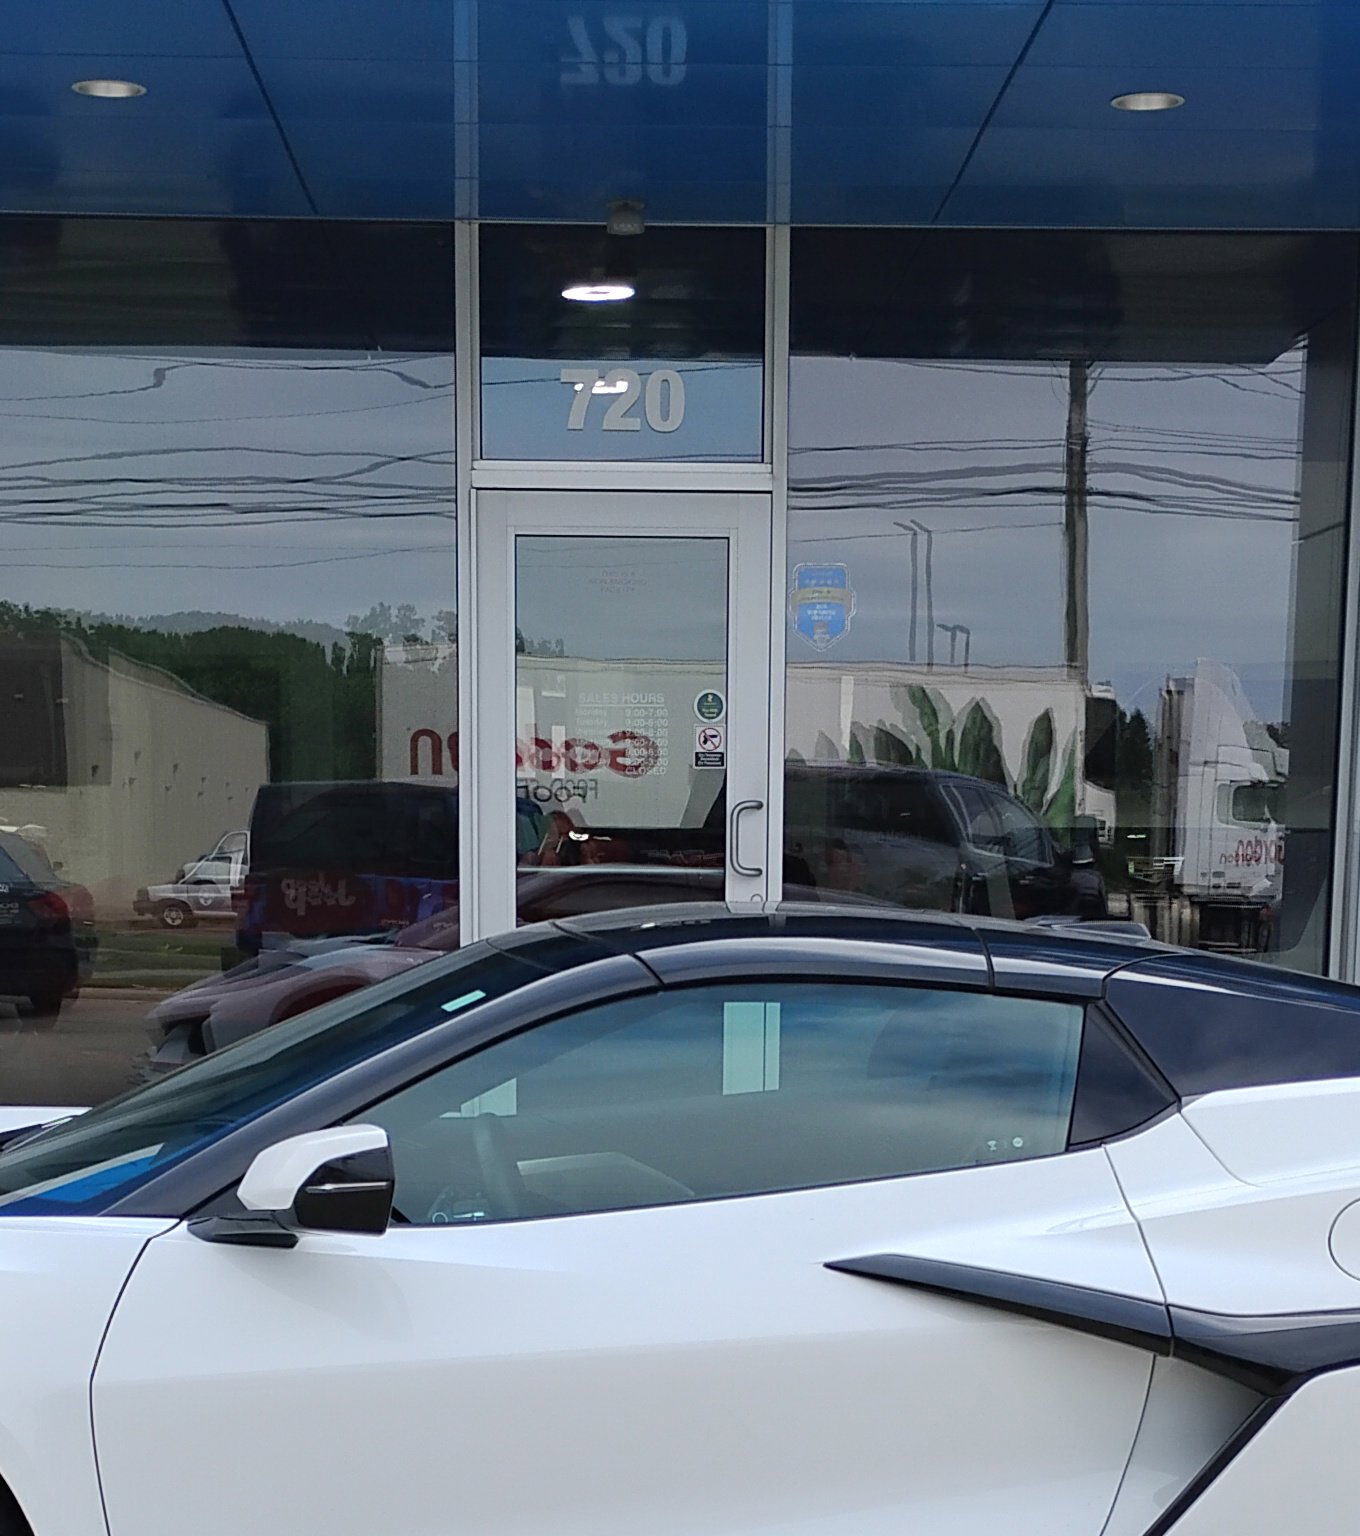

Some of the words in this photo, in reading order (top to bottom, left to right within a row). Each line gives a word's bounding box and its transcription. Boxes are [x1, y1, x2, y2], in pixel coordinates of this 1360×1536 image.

[560, 368, 686, 433] 720
[578, 692, 618, 704] SALES
[622, 692, 665, 704] HOURS
